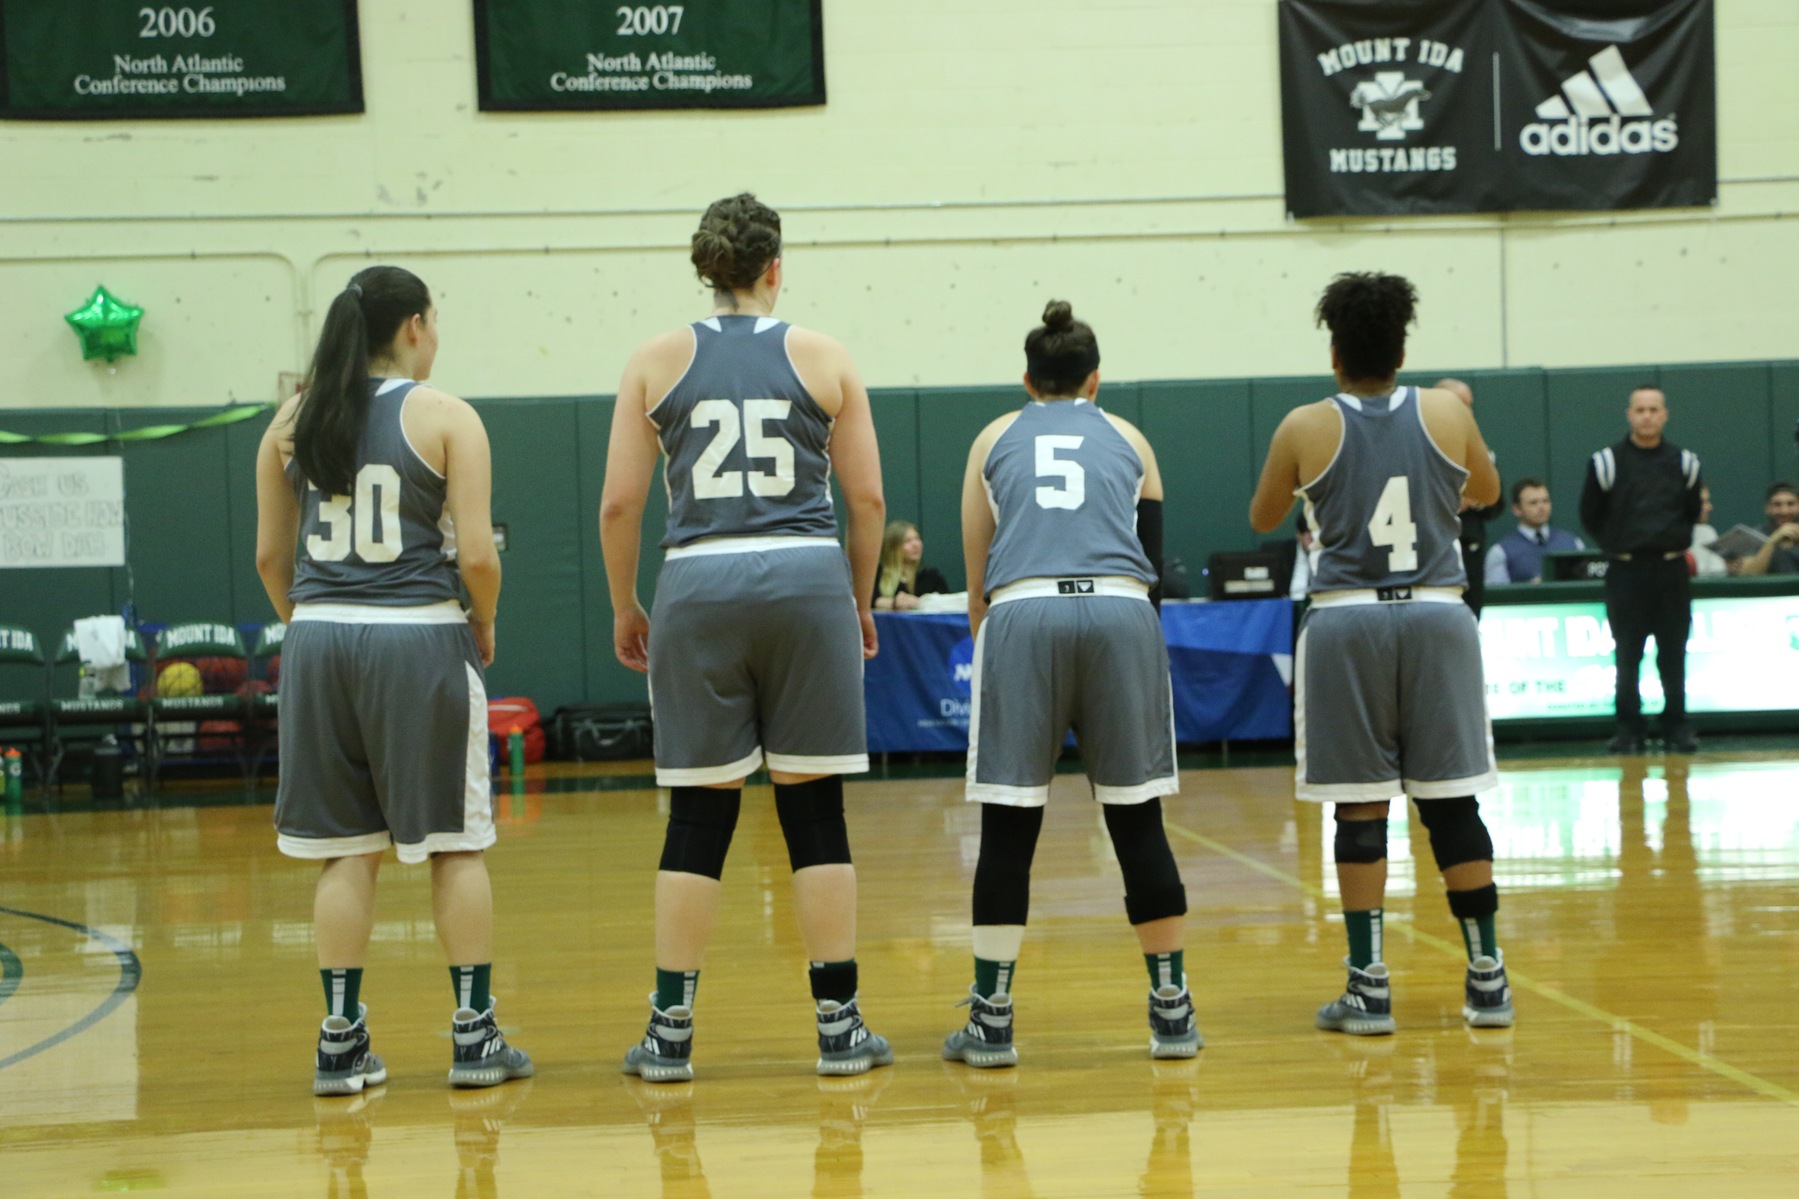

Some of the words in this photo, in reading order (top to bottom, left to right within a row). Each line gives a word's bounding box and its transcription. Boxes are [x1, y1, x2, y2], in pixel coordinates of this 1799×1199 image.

[139, 7, 215, 38] 2006
[616, 6, 684, 36] 2007
[114, 54, 167, 74] North
[172, 53, 243, 73] Atlantic
[586, 52, 641, 72] North
[645, 52, 716, 72] Atlantic
[1317, 37, 1411, 76] MOUNT
[1417, 39, 1465, 73] IDA
[74, 74, 179, 95] Conference
[183, 75, 286, 96] Champions
[550, 72, 650, 92] Conference
[653, 71, 753, 93] Champions
[1520, 114, 1678, 155] adidas
[1330, 147, 1457, 173] MUSTANGS
[690, 399, 795, 500] 25
[1034, 435, 1085, 510] 5
[306, 463, 403, 563] 30
[1368, 476, 1418, 573] 4
[165, 623, 212, 649] MOUNT
[214, 624, 235, 646] IDA
[1508, 680, 1528, 694] OF
[1534, 679, 1566, 694] THE
